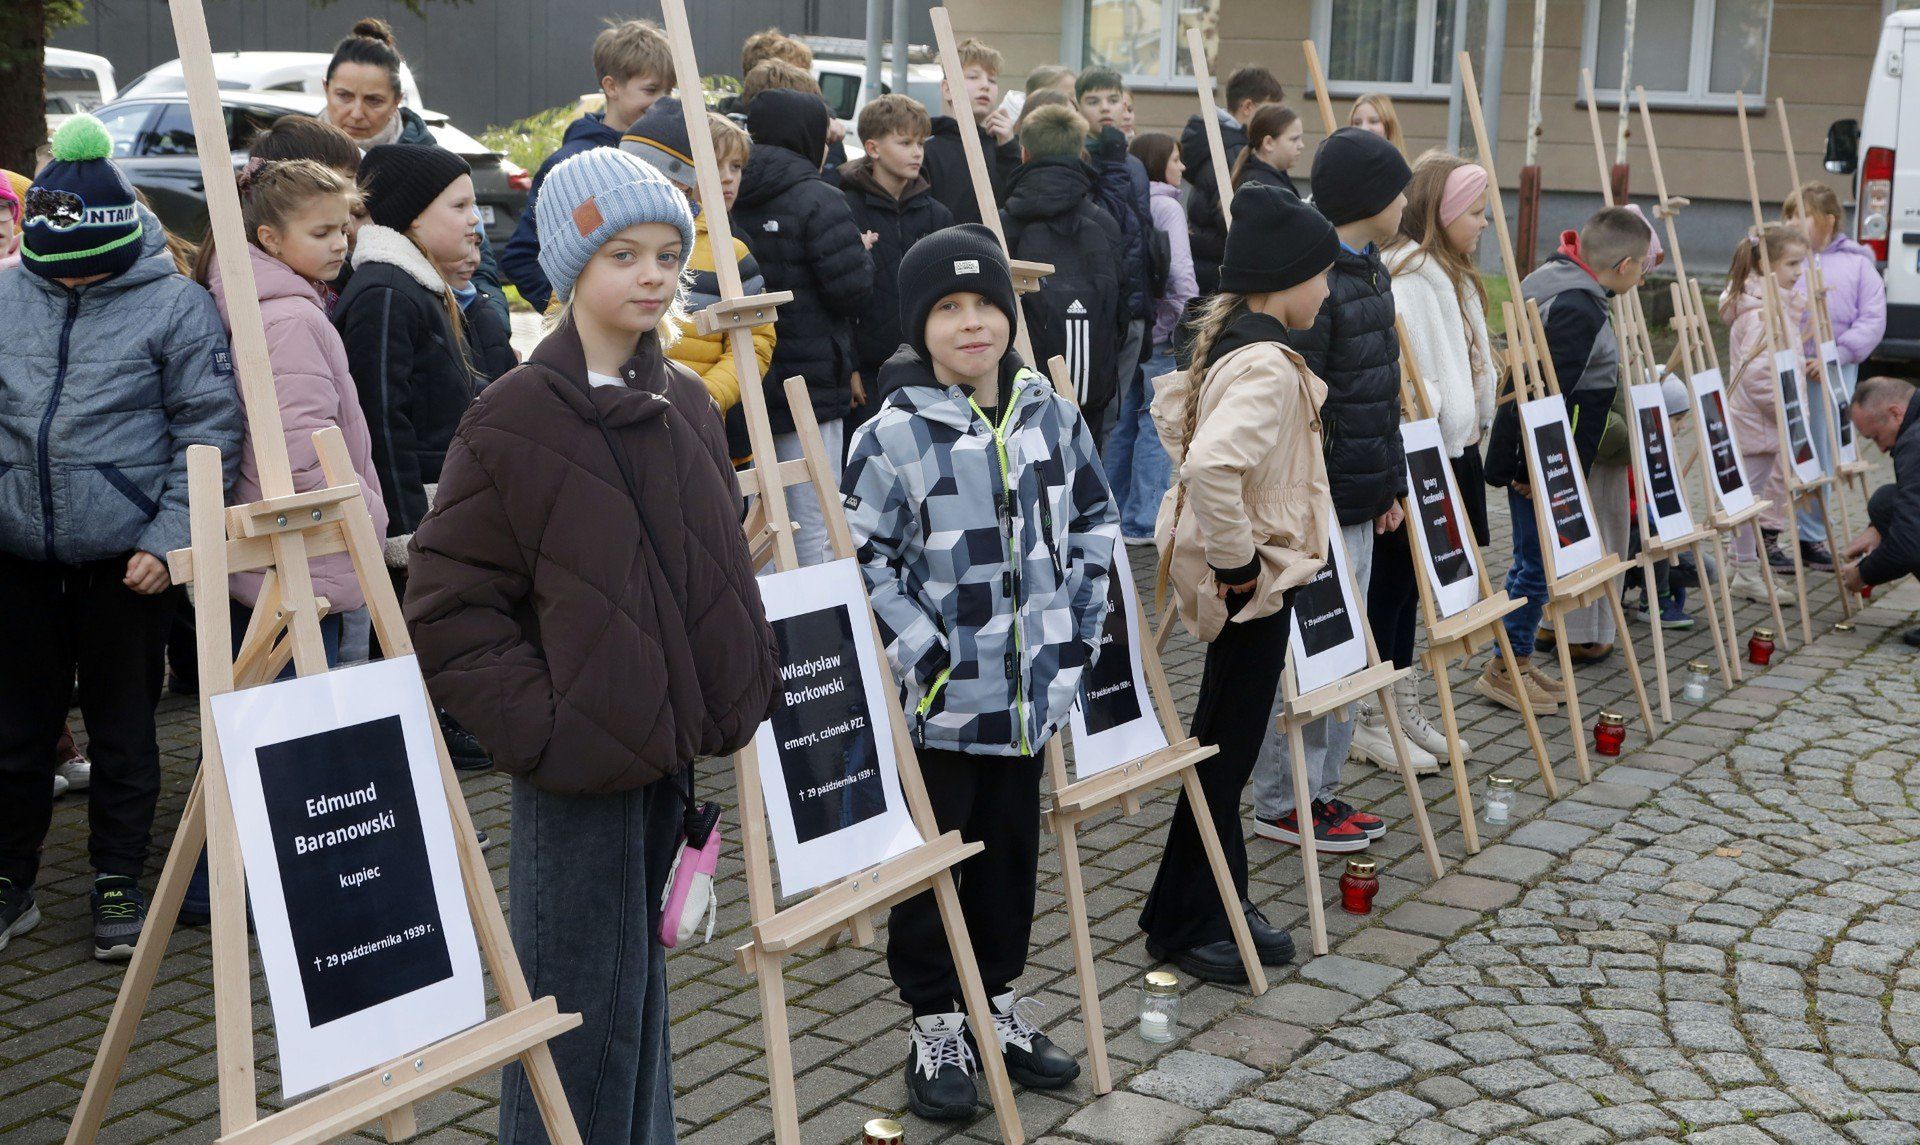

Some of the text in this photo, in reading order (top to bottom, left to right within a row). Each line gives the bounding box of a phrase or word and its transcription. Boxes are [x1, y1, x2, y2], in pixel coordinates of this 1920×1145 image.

[780, 654, 841, 682] Władysław
[784, 676, 845, 707] Borkowski
[784, 716, 865, 751] emeryt, członek PZZ
[807, 787, 817, 798] 29
[817, 774, 857, 797] października
[857, 770, 870, 783] 1939
[306, 782, 378, 818] Edmund
[295, 810, 395, 855] Baranowski
[339, 864, 381, 889] kupiec
[104, 890, 123, 898] FILA
[326, 953, 339, 969] 29
[340, 933, 402, 966] października
[403, 923, 426, 942] 1939
[427, 923, 435, 934] r.
